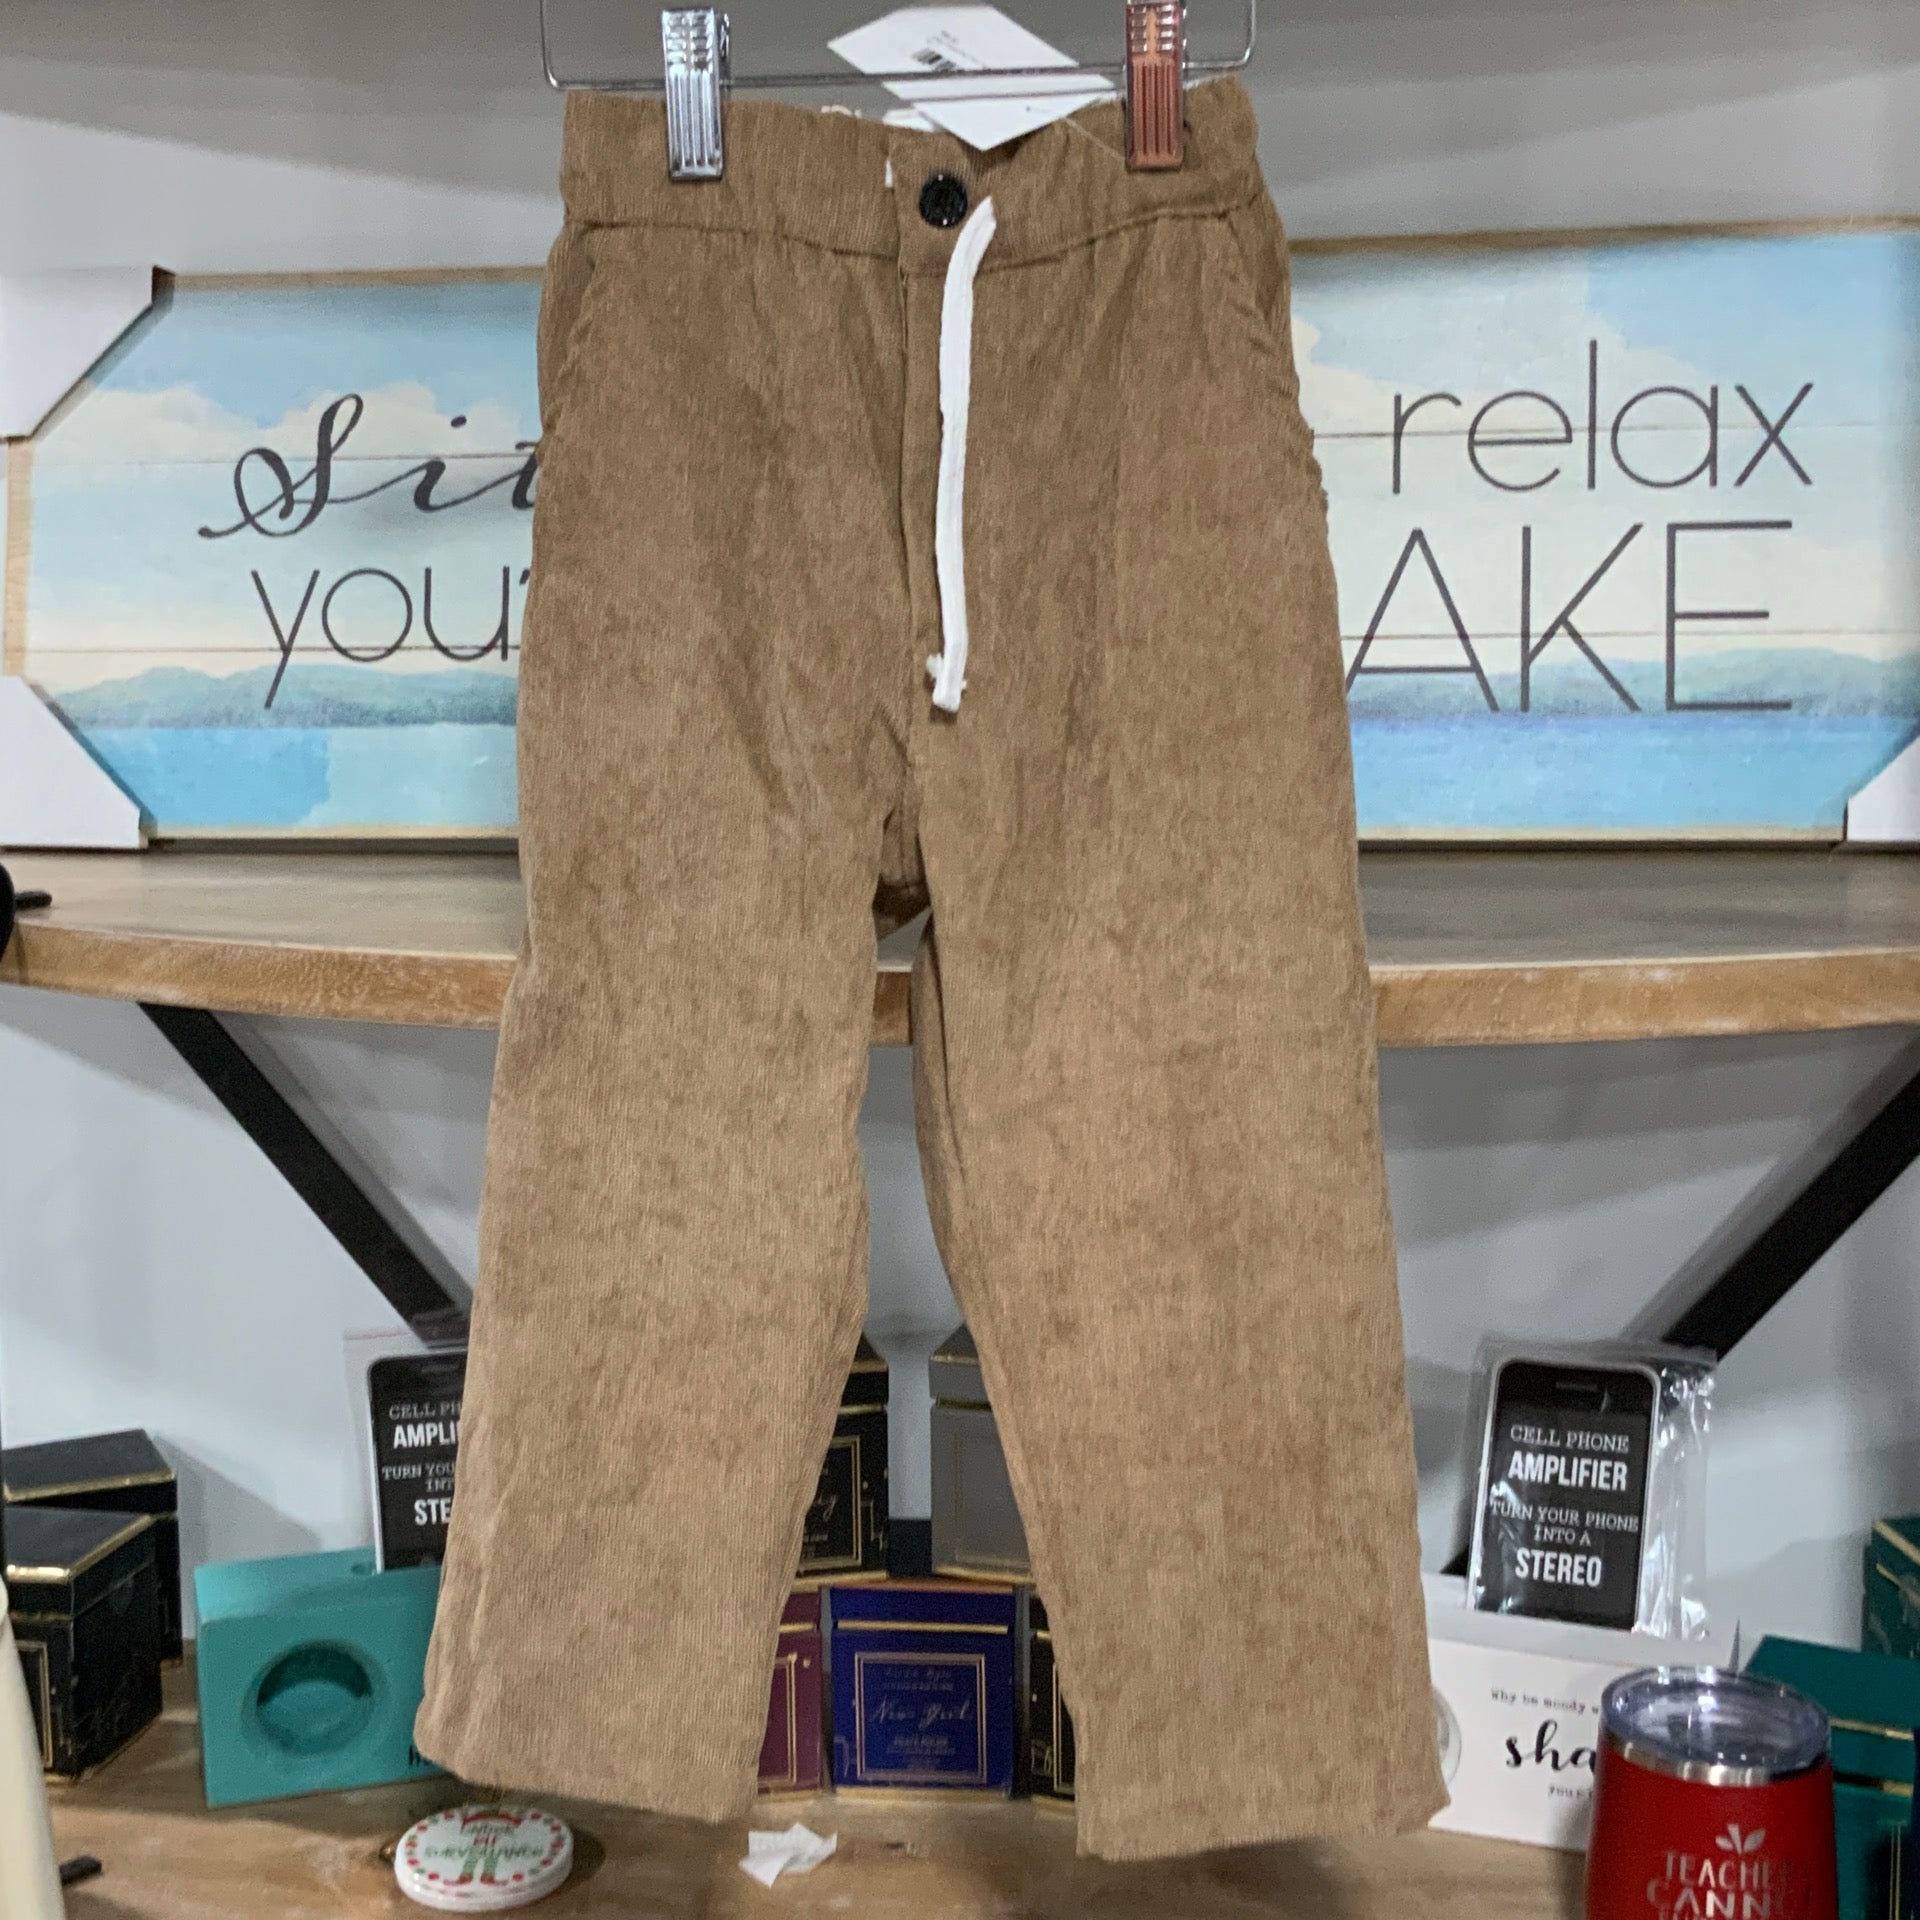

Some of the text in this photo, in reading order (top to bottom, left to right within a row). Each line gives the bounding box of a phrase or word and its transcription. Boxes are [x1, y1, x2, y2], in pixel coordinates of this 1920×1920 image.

[1392, 338, 1814, 495] relax
[388, 1402, 436, 1421] CELL
[394, 1420, 460, 1448] AMPLI
[1510, 1424, 1629, 1454] CELL PHONE
[381, 1465, 422, 1482] TURN
[1508, 1450, 1628, 1492] AMPLIFIER
[1491, 1501, 1639, 1533] TURN YOUR PHONE
[1534, 1525, 1591, 1547] INTO A
[1515, 1547, 1602, 1588] STEREO
